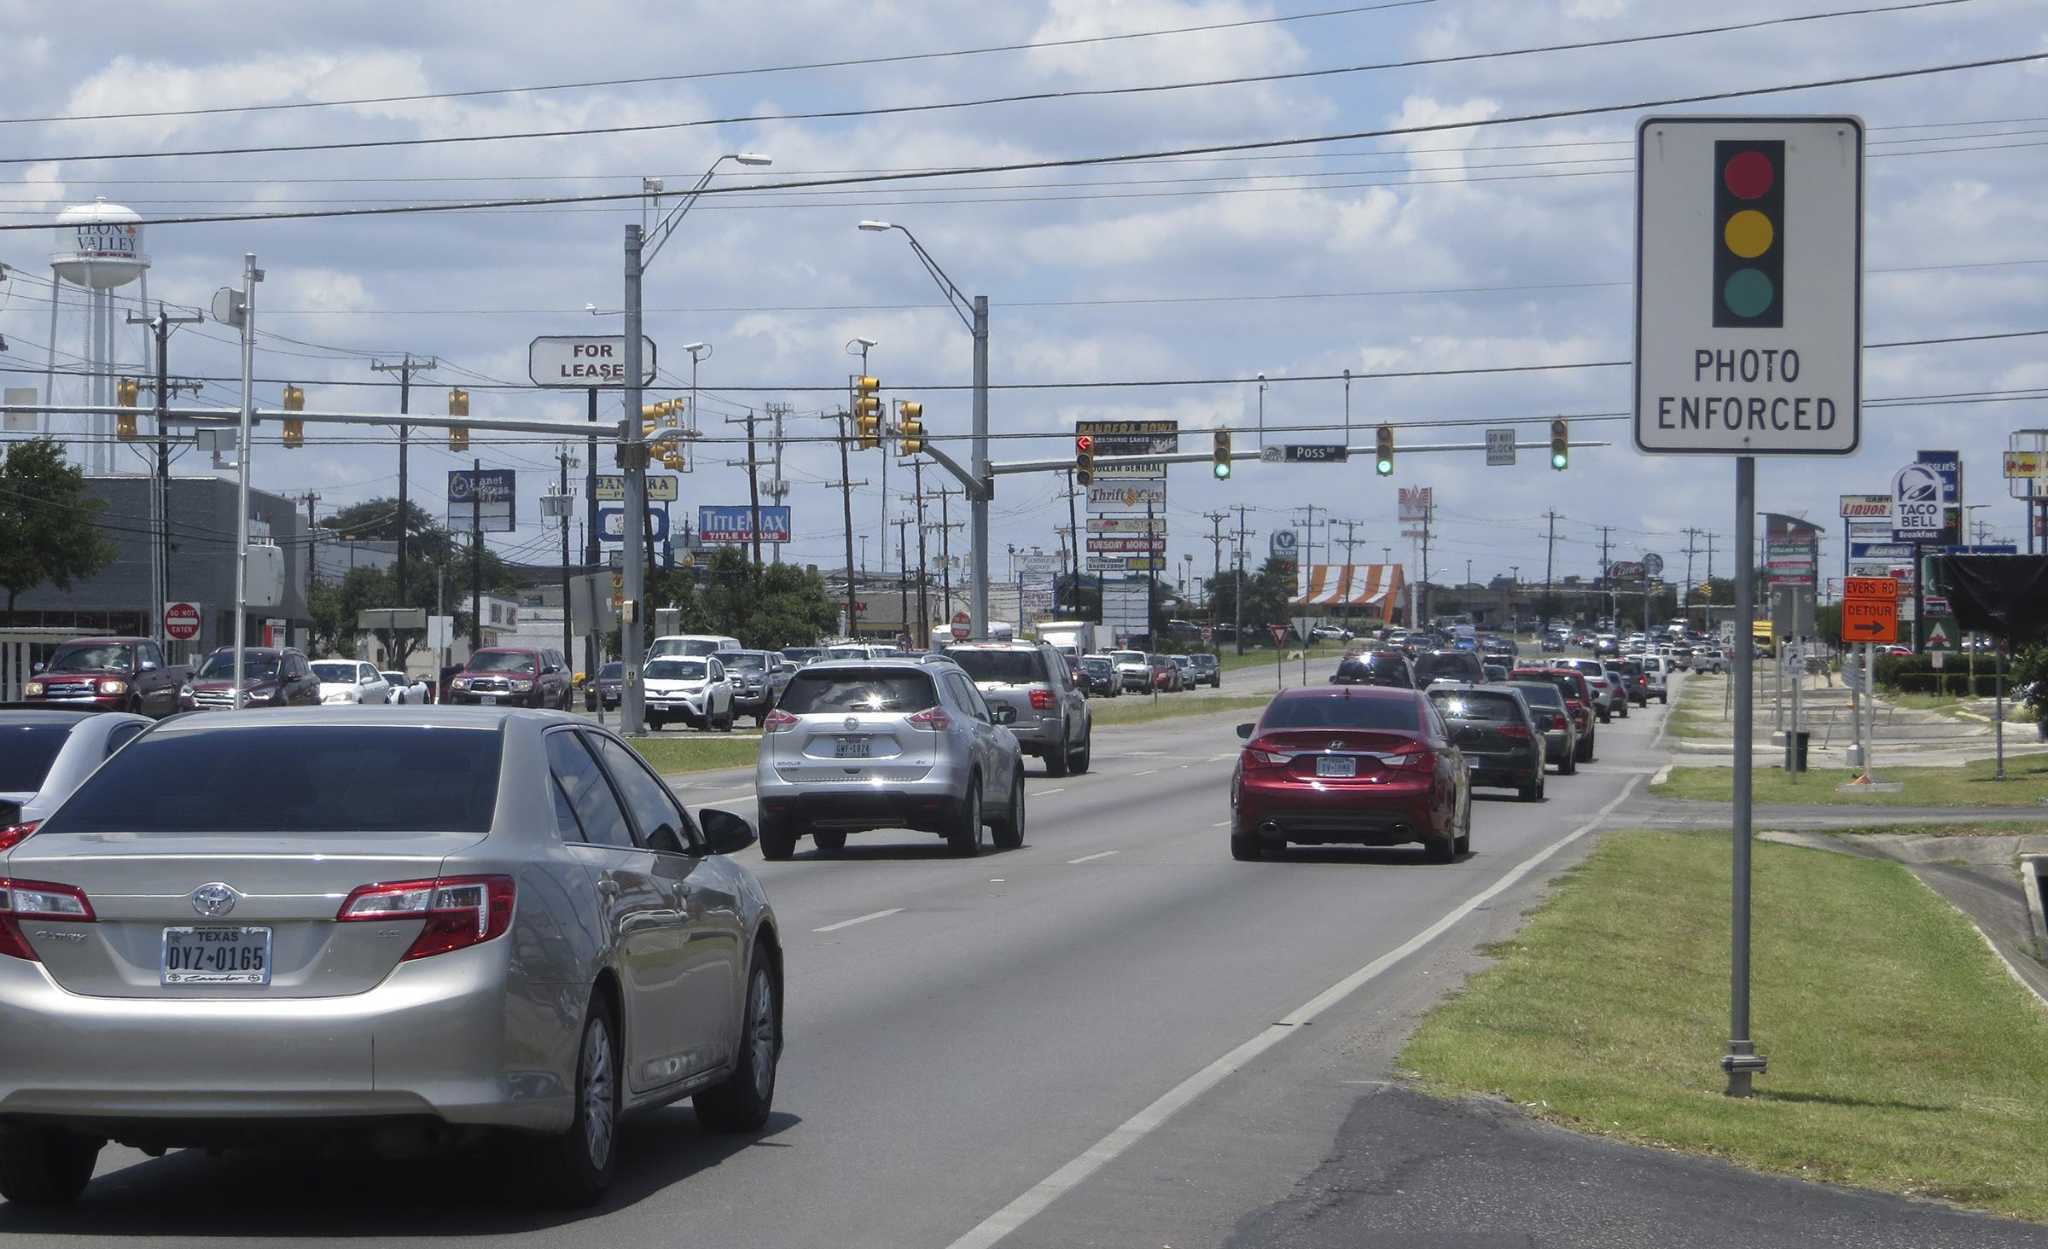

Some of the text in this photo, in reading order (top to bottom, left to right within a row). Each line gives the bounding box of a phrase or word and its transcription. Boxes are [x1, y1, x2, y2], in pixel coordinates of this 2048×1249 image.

[77, 236, 136, 251] VALLEY
[573, 344, 613, 358] FOR
[560, 364, 624, 378] LEASE
[1695, 349, 1800, 382] PHOTO
[1658, 396, 1836, 430] ENFORCED
[595, 477, 669, 491] BANRA
[1842, 504, 1885, 515] LIQUOR
[1899, 504, 1937, 516] TACO
[1901, 516, 1937, 527] BELL
[709, 532, 780, 540] TITLE LANS
[182, 609, 195, 617] NOT
[1848, 605, 1892, 616] DETOUR
[171, 626, 193, 634] ENTER
[197, 931, 240, 942] TEXAS
